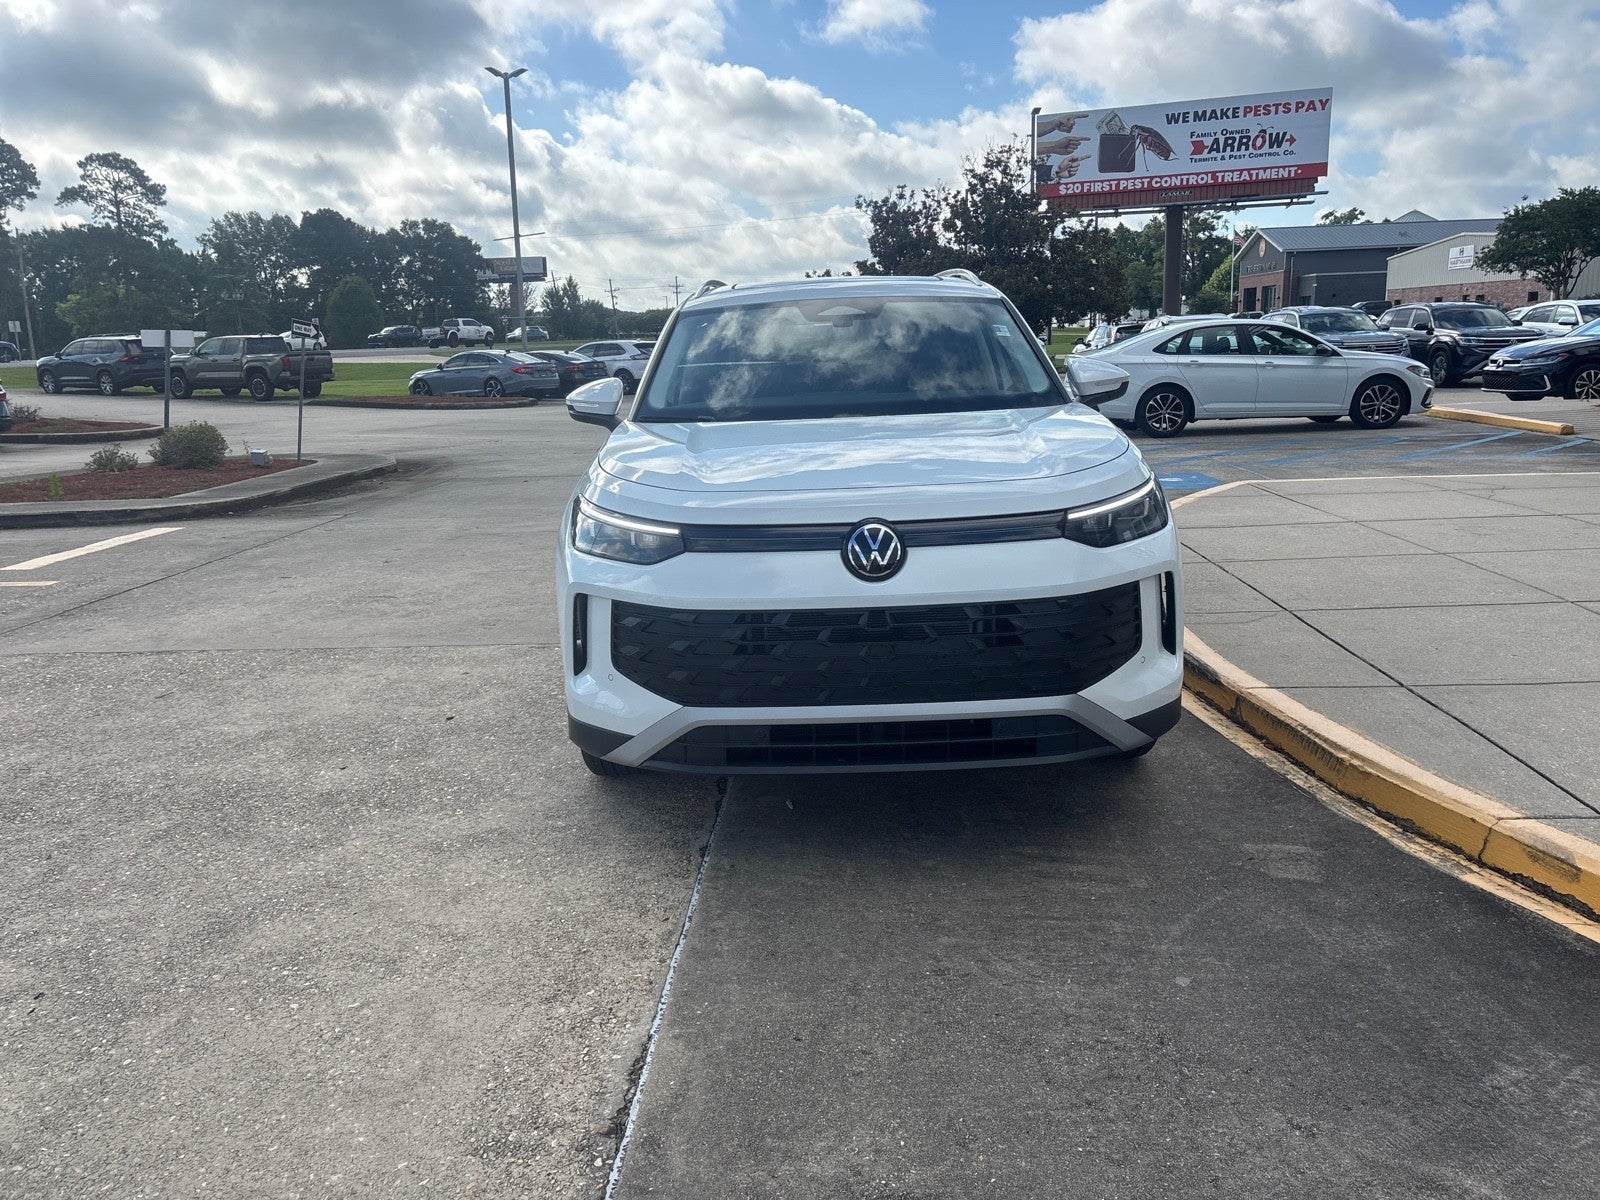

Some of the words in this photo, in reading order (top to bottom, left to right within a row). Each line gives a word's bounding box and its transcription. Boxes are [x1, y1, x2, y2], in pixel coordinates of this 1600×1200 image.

[1165, 112, 1190, 125] WE
[1193, 107, 1240, 122] MAKE
[1243, 102, 1292, 118] PESTS
[1294, 98, 1330, 113] PAY
[1190, 131, 1218, 139] FAMILY
[1220, 128, 1250, 136] OWNED
[1207, 131, 1287, 154] ARROW
[1189, 155, 1219, 163] TERMITE
[1248, 151, 1281, 159] CONTROL
[1059, 183, 1081, 195] $20
[1083, 181, 1118, 193] FIRST
[1120, 178, 1150, 190] PEST
[1152, 173, 1214, 187] CONTROL
